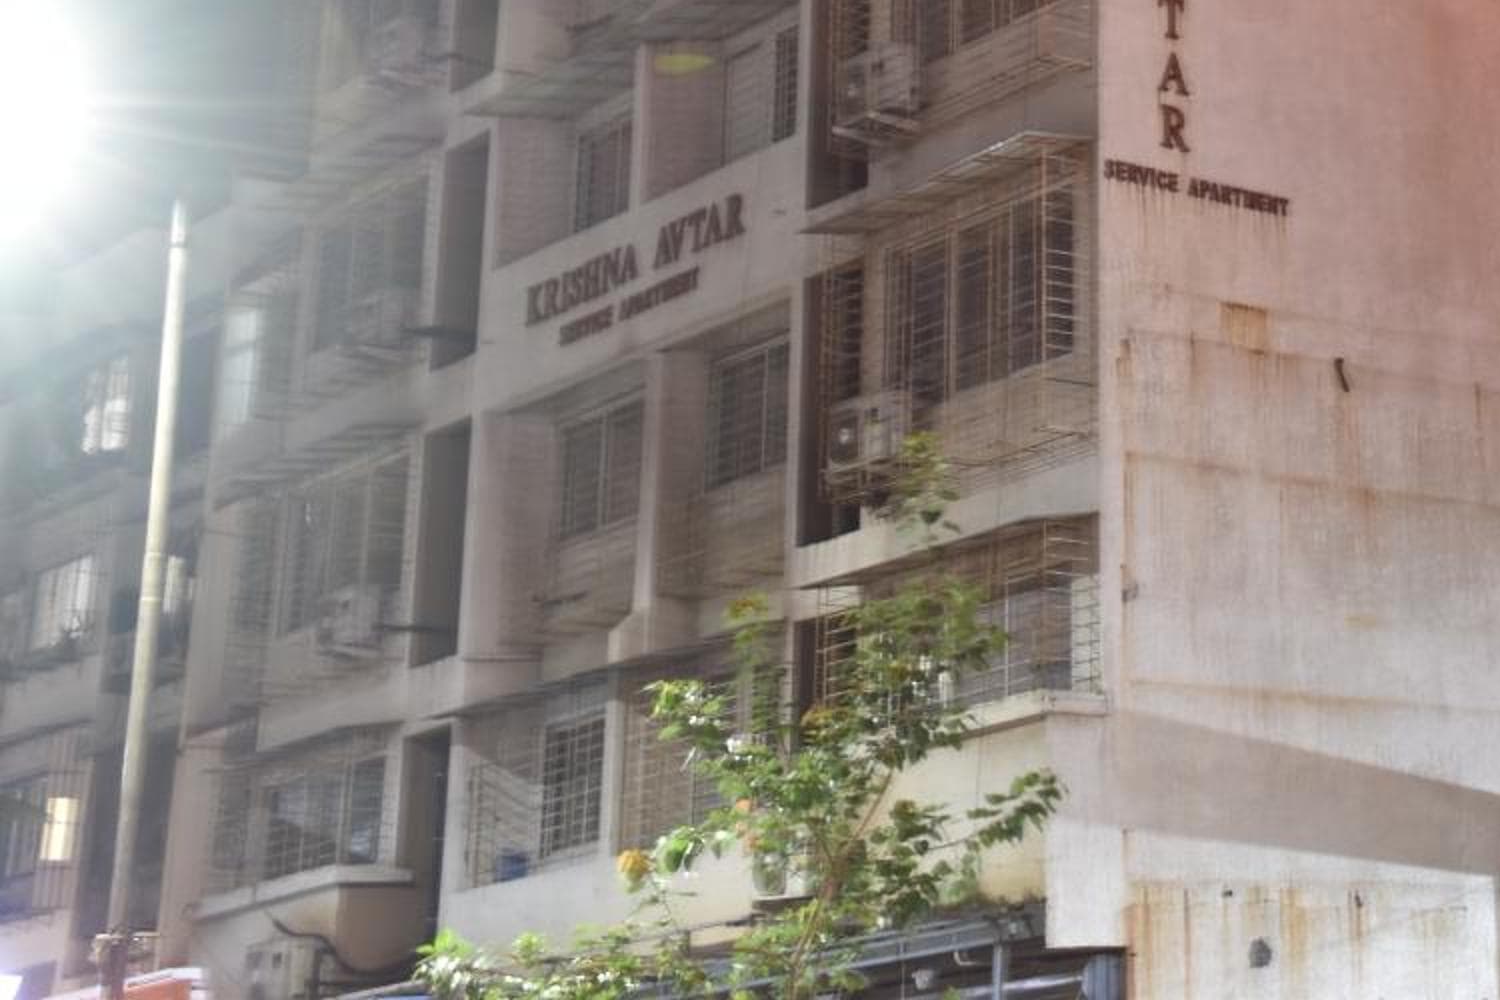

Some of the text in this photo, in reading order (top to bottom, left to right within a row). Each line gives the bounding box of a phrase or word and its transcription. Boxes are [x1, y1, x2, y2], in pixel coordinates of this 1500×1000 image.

[1103, 158, 1291, 217] SERVICE APARTMENT
[524, 192, 746, 328] KRISHNA AVTAR
